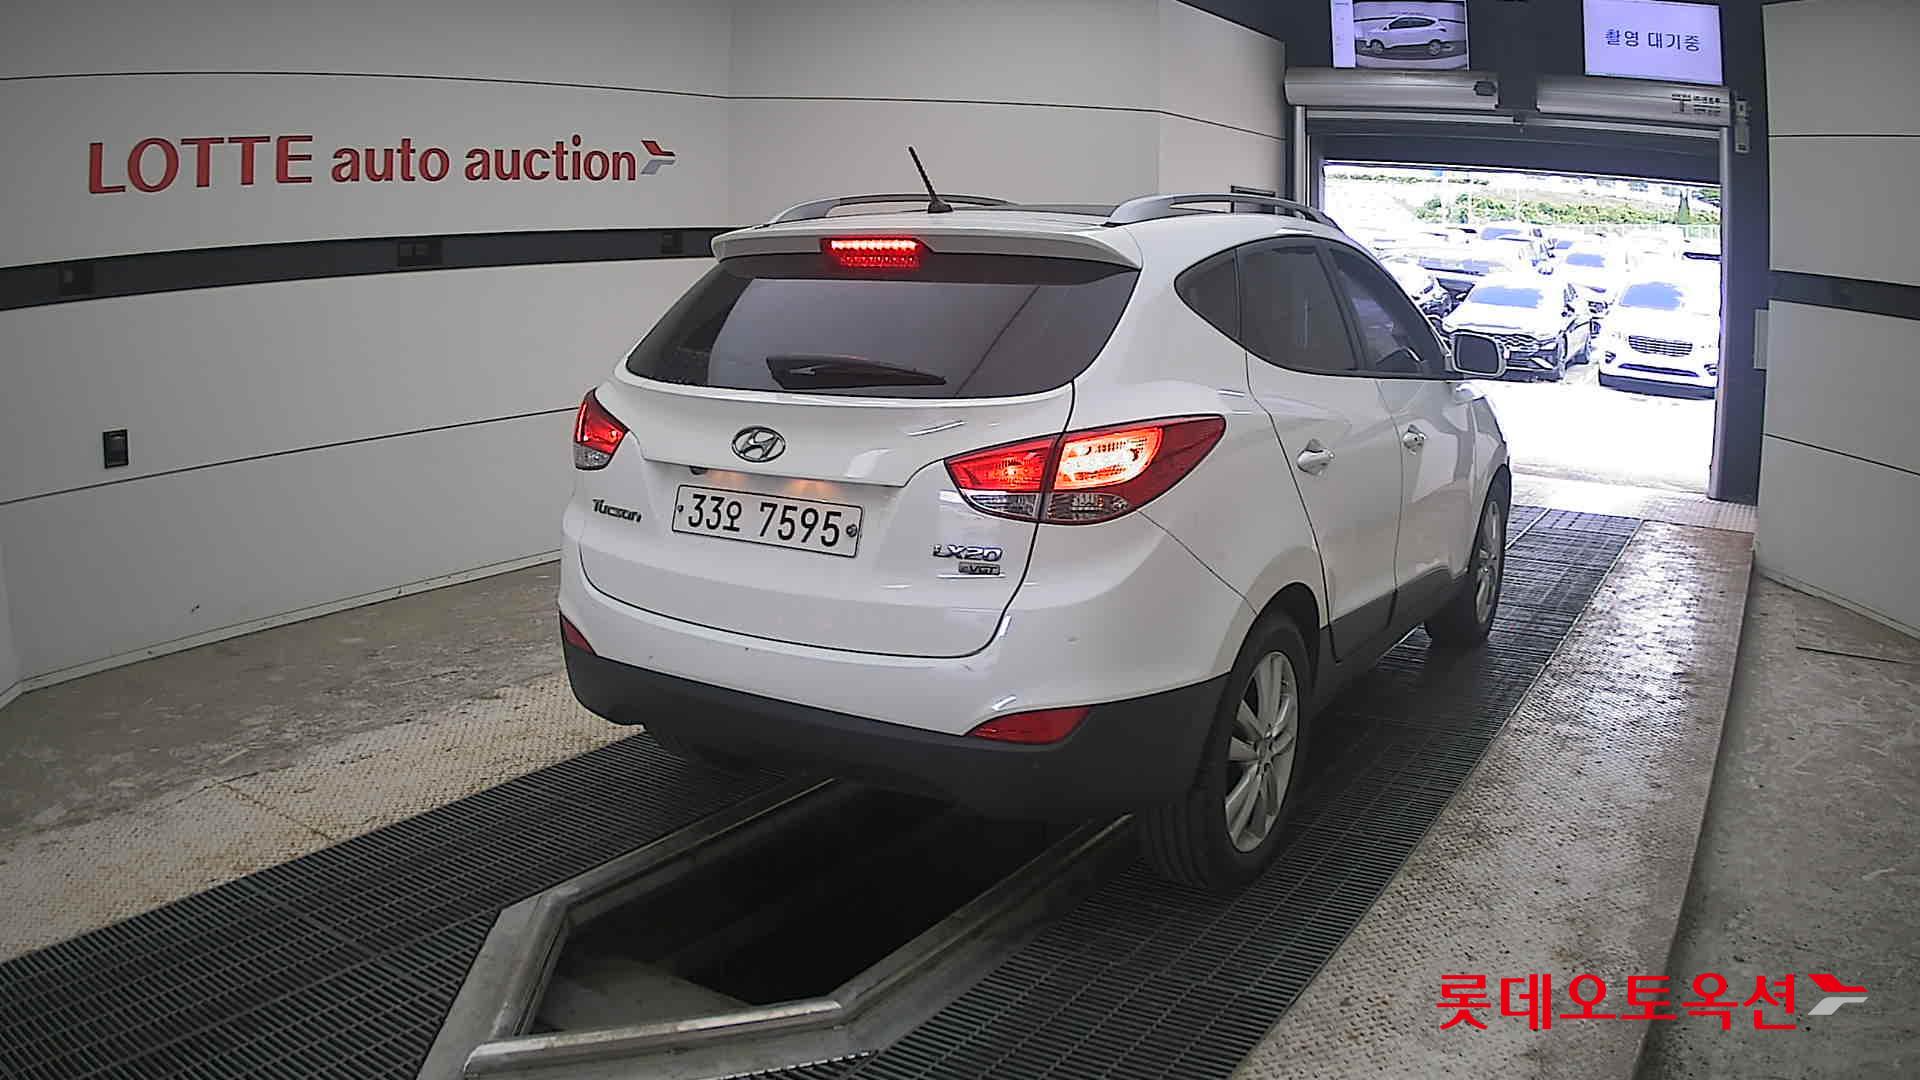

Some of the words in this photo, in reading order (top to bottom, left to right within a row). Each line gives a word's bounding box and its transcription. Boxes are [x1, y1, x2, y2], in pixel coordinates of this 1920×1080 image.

[1647, 31, 1700, 52] 대기중
[88, 135, 314, 194] LOTTE
[331, 138, 450, 183] auto
[463, 134, 637, 182] auction
[592, 499, 642, 522] Tucson
[688, 493, 743, 533] 33오
[759, 501, 842, 547] 7595
